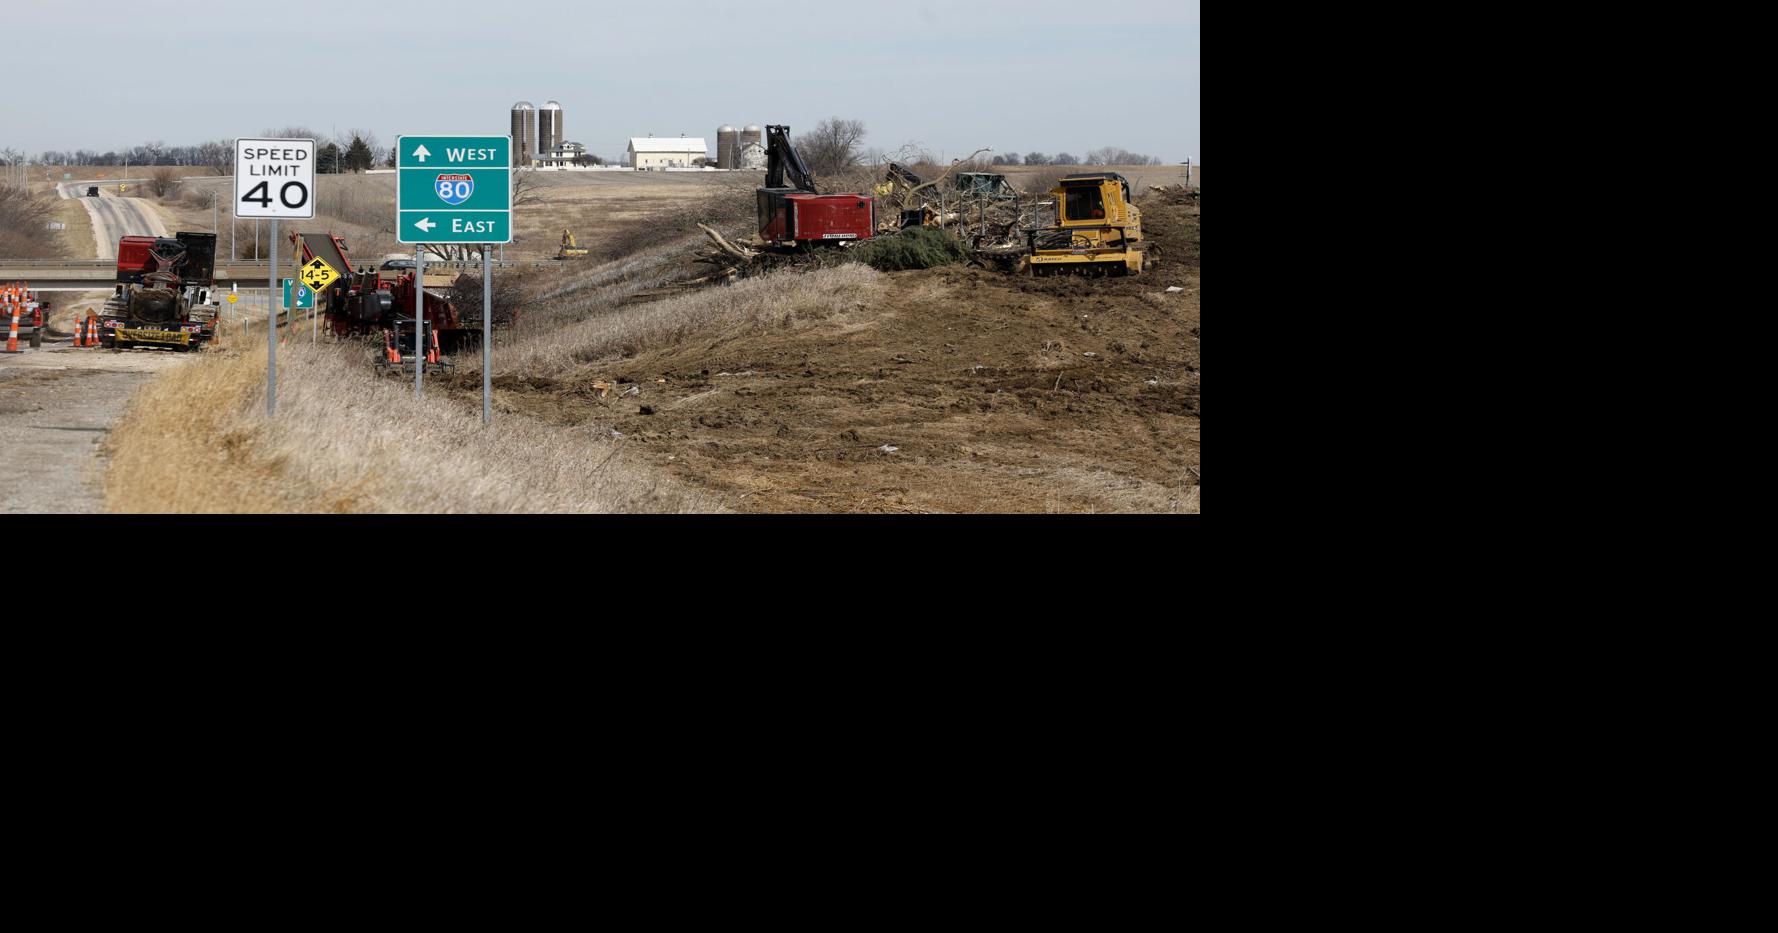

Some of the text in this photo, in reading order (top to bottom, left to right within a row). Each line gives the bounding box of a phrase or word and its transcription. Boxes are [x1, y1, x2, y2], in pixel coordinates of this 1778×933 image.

[244, 148, 308, 161] SPEED
[446, 147, 497, 163] WEST
[250, 165, 300, 176] LIMIT
[241, 180, 308, 209] 40
[439, 181, 470, 199] 80
[452, 218, 496, 234] EAST
